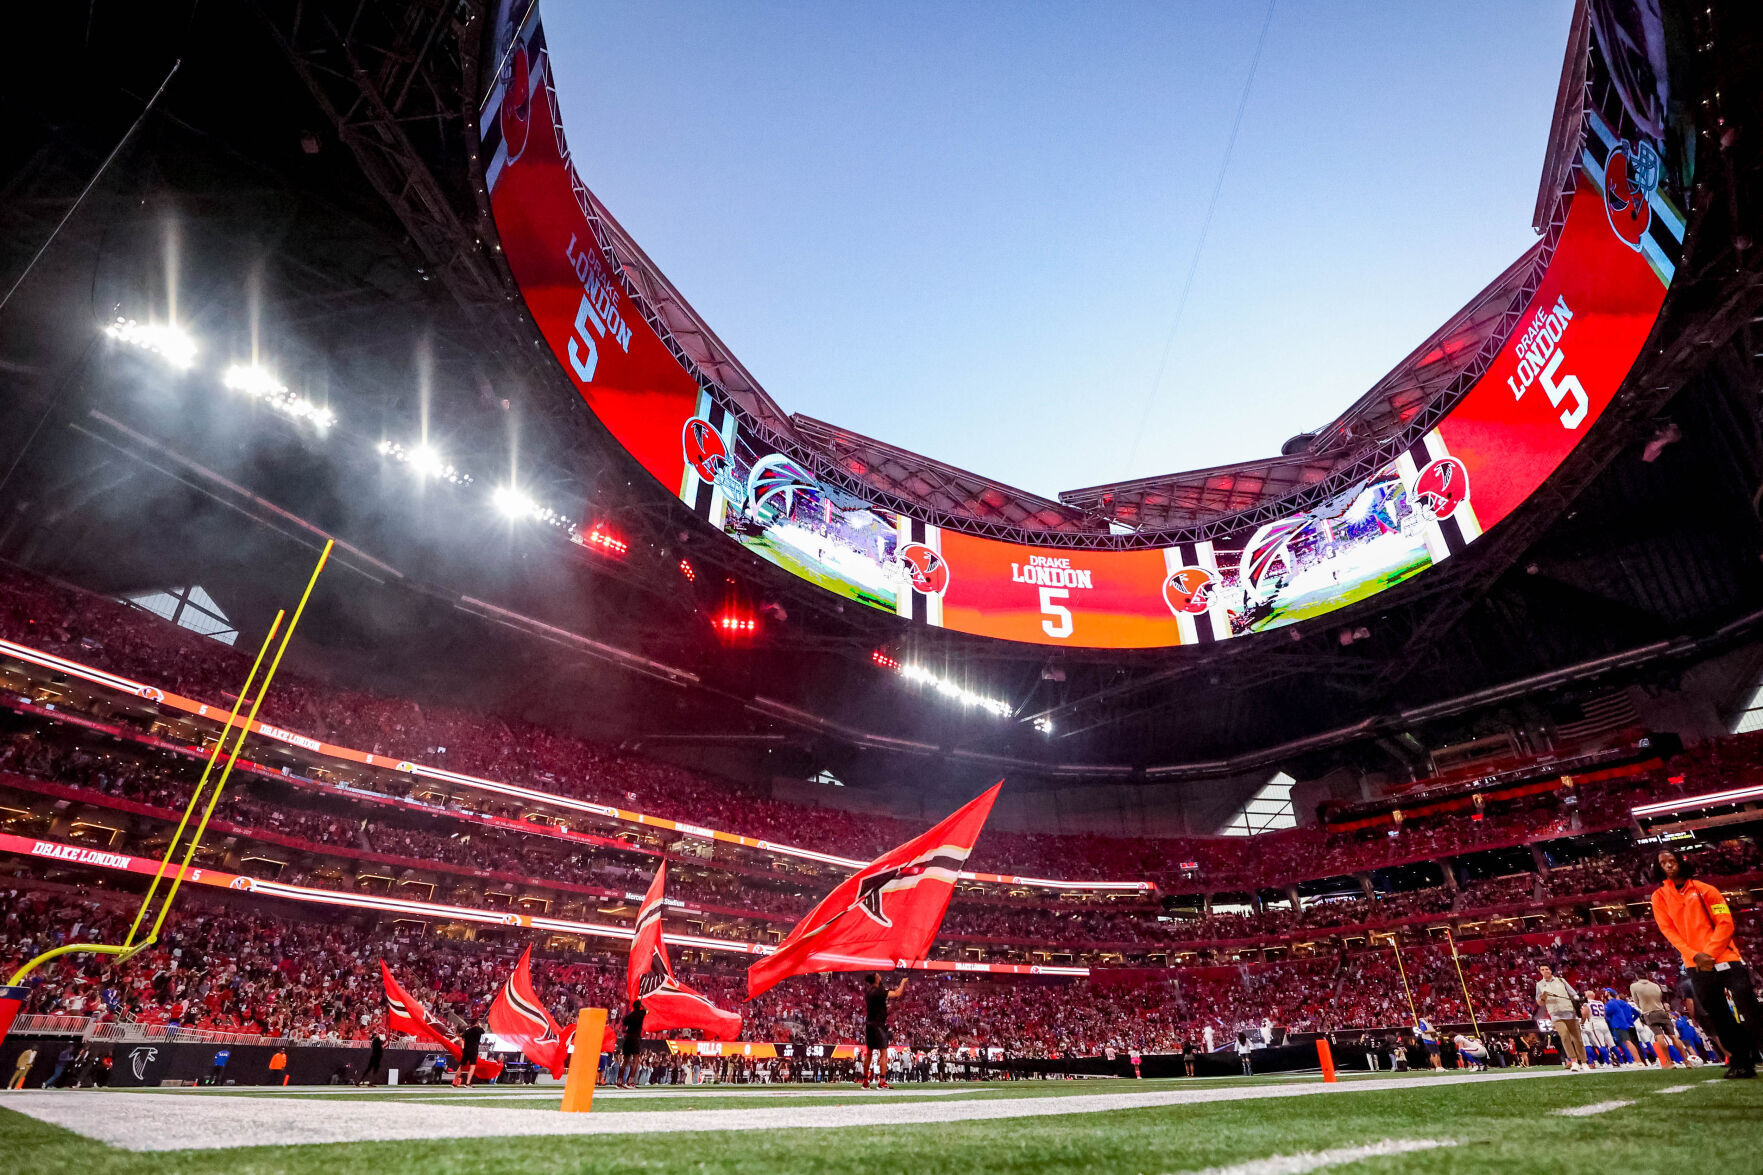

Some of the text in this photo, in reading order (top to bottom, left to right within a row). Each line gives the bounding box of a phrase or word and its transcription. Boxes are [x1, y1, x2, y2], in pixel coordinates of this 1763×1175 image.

[566, 232, 633, 354] LONDON
[587, 247, 621, 307] DRAKE
[567, 293, 605, 382] 5
[1507, 294, 1574, 401] LONDON
[1515, 306, 1548, 359] DRAKE
[1538, 348, 1589, 430] 5
[1011, 563, 1093, 589] LONDON
[1029, 555, 1071, 569] DRAKE
[1038, 586, 1074, 638] 5
[199, 705, 208, 716] 5
[259, 725, 321, 751] DRAKE LONDON
[32, 842, 131, 868] DRAKE LONDON
[191, 870, 202, 881] 5
